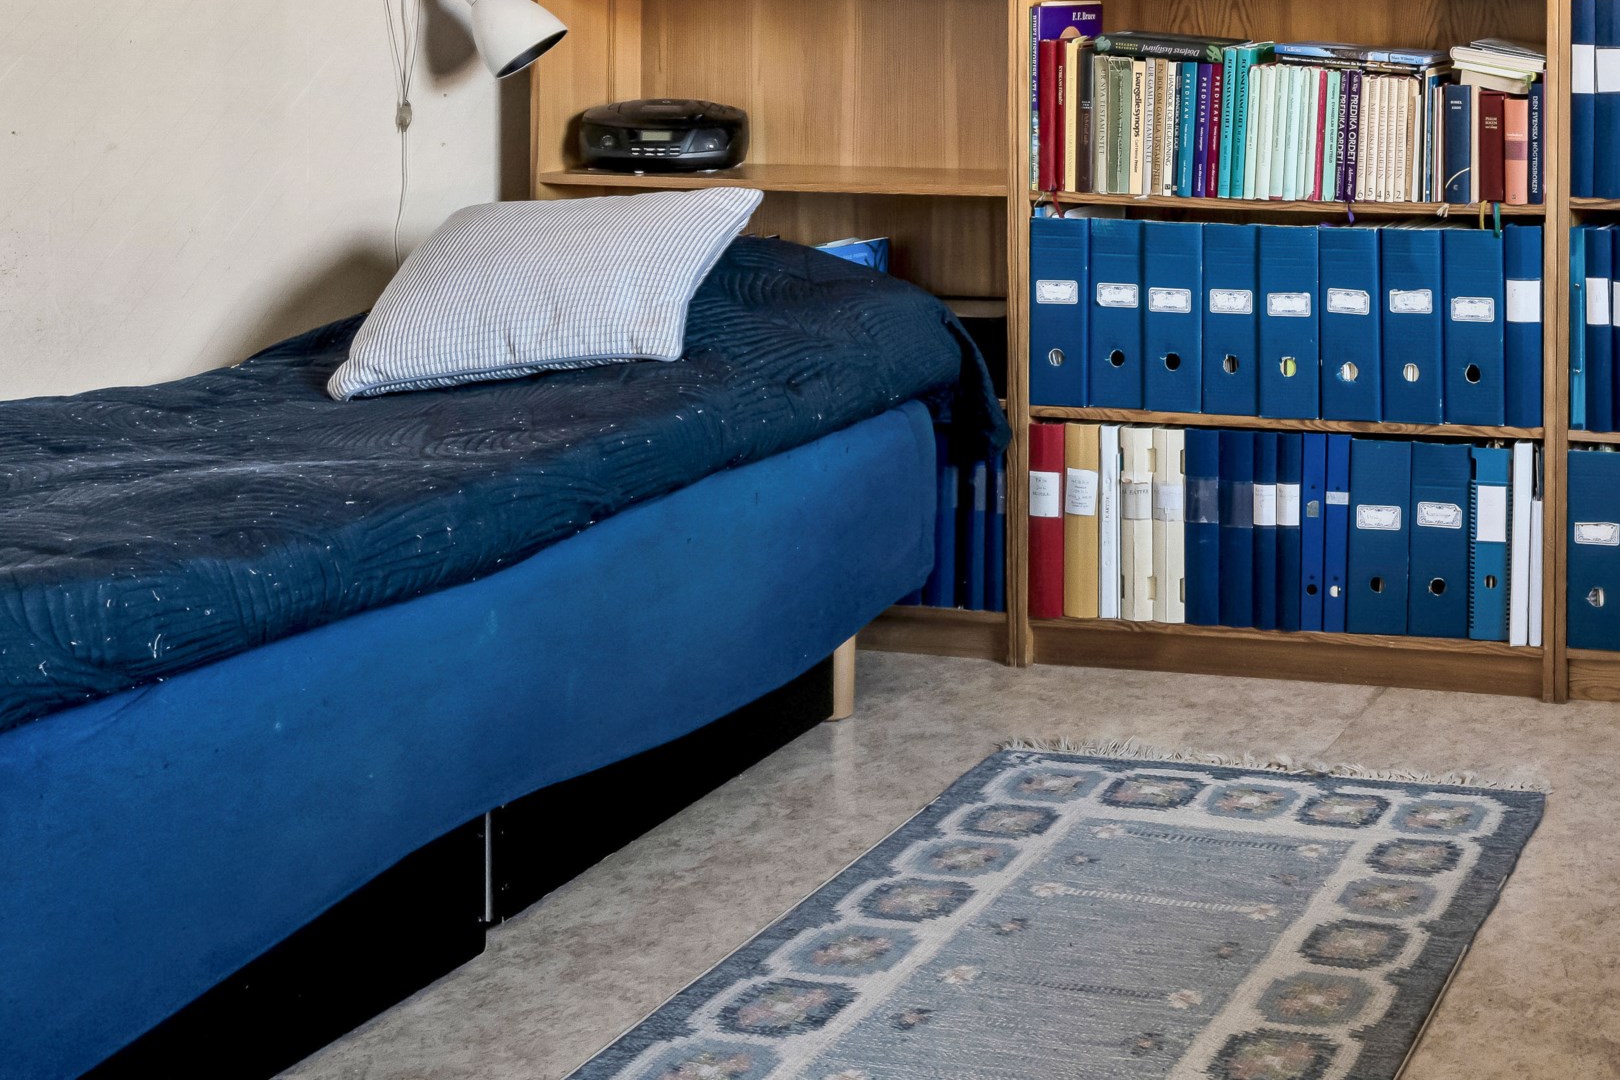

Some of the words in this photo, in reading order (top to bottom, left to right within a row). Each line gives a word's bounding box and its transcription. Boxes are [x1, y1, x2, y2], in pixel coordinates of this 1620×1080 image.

[1148, 67, 1154, 77] UR
[1157, 64, 1163, 74] EN
[1156, 94, 1162, 106] OM
[1166, 110, 1174, 122] FÖR
[1338, 95, 1346, 128] PREDIKA
[1349, 95, 1358, 130] PREDIKA
[1336, 131, 1344, 163] ORDET!
[1347, 134, 1357, 165] ORDET!
[1367, 126, 1375, 177] VERKLIGHETEN
[1377, 128, 1385, 178] VERKLIGHETEN
[1396, 128, 1404, 178] VERKLIGHETEN
[1154, 137, 1162, 187] TESTAMENTET
[1357, 190, 1363, 199] 6
[1367, 187, 1374, 197] 5
[1376, 191, 1382, 200] 4
[1385, 191, 1391, 199] 3
[1396, 190, 1402, 199] 2
